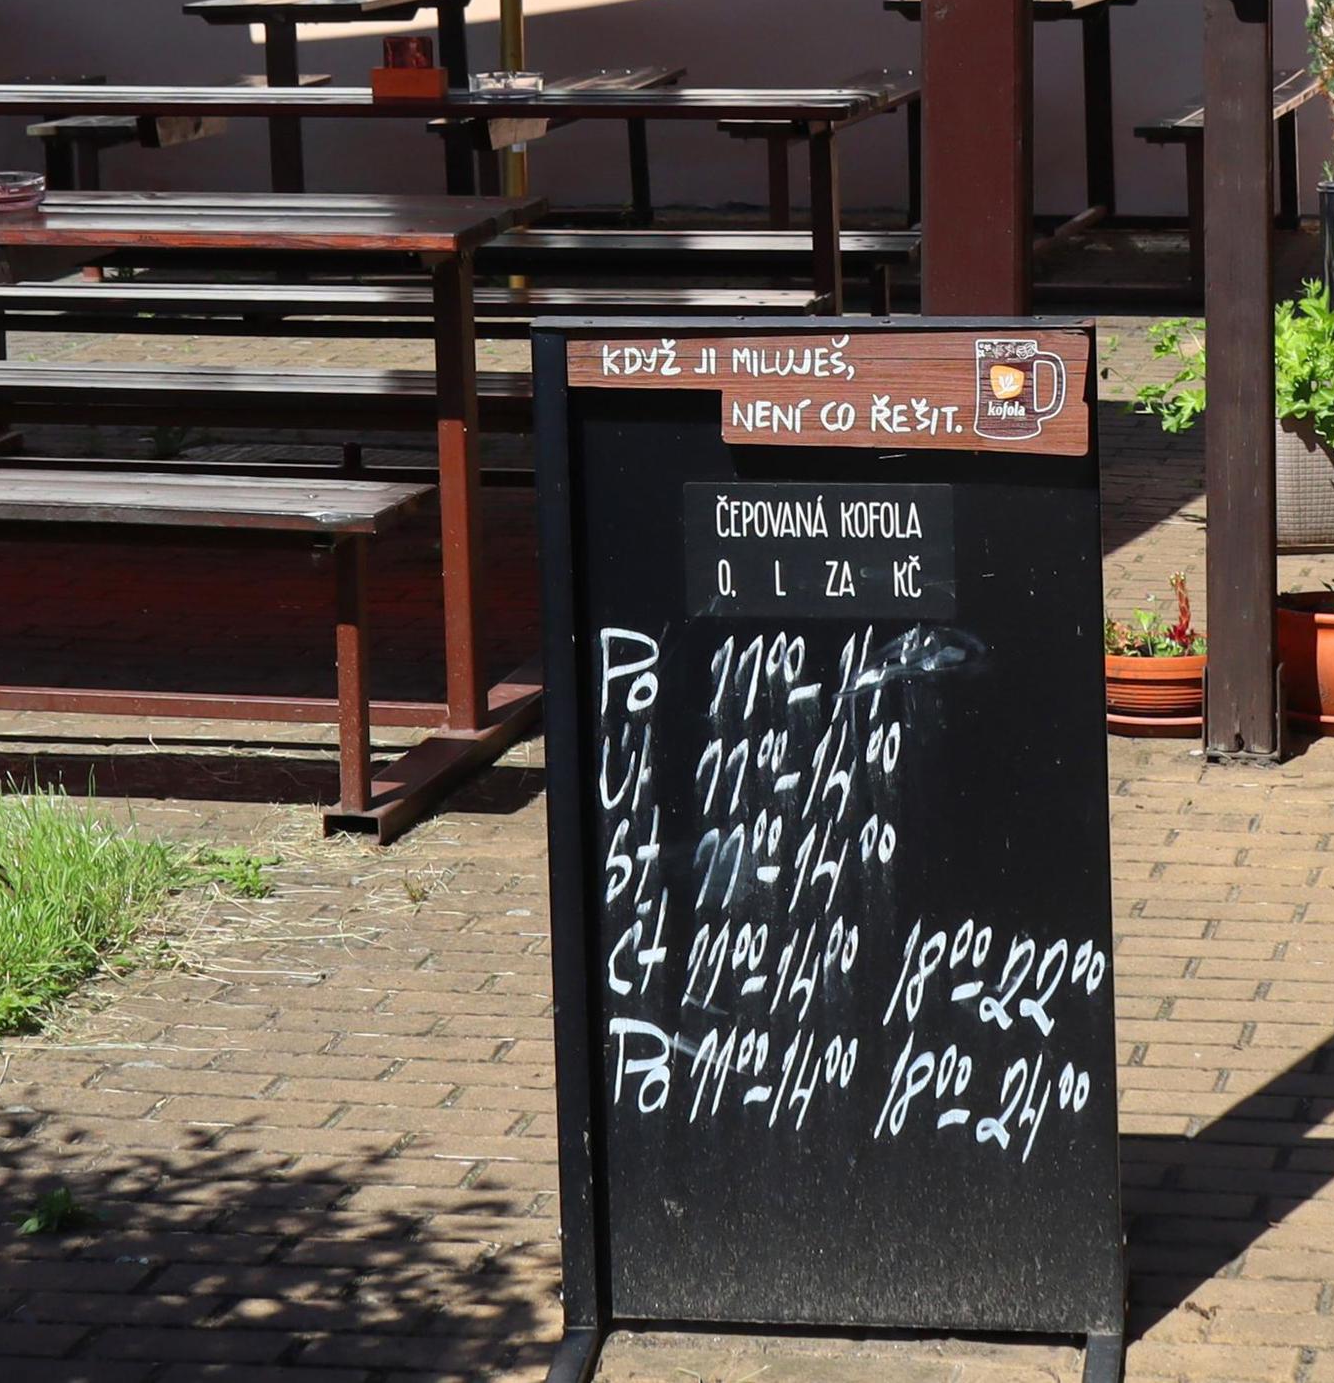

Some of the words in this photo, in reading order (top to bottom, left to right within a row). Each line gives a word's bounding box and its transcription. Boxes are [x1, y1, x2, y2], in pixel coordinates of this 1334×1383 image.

[602, 338, 682, 377] KDYŽ
[693, 346, 717, 376] JI
[731, 334, 856, 382] MILUJEŠ,
[731, 397, 813, 434] NENÍ
[819, 400, 856, 433] CO
[870, 393, 964, 436] ŘEŠIT.
[987, 400, 1026, 421] kofola
[715, 494, 830, 539] ČEPOVANÁ
[839, 500, 923, 540] KOFOLA
[774, 559, 788, 597] L
[824, 559, 857, 598] ZA
[892, 554, 923, 599] KČ
[599, 627, 660, 717] Po
